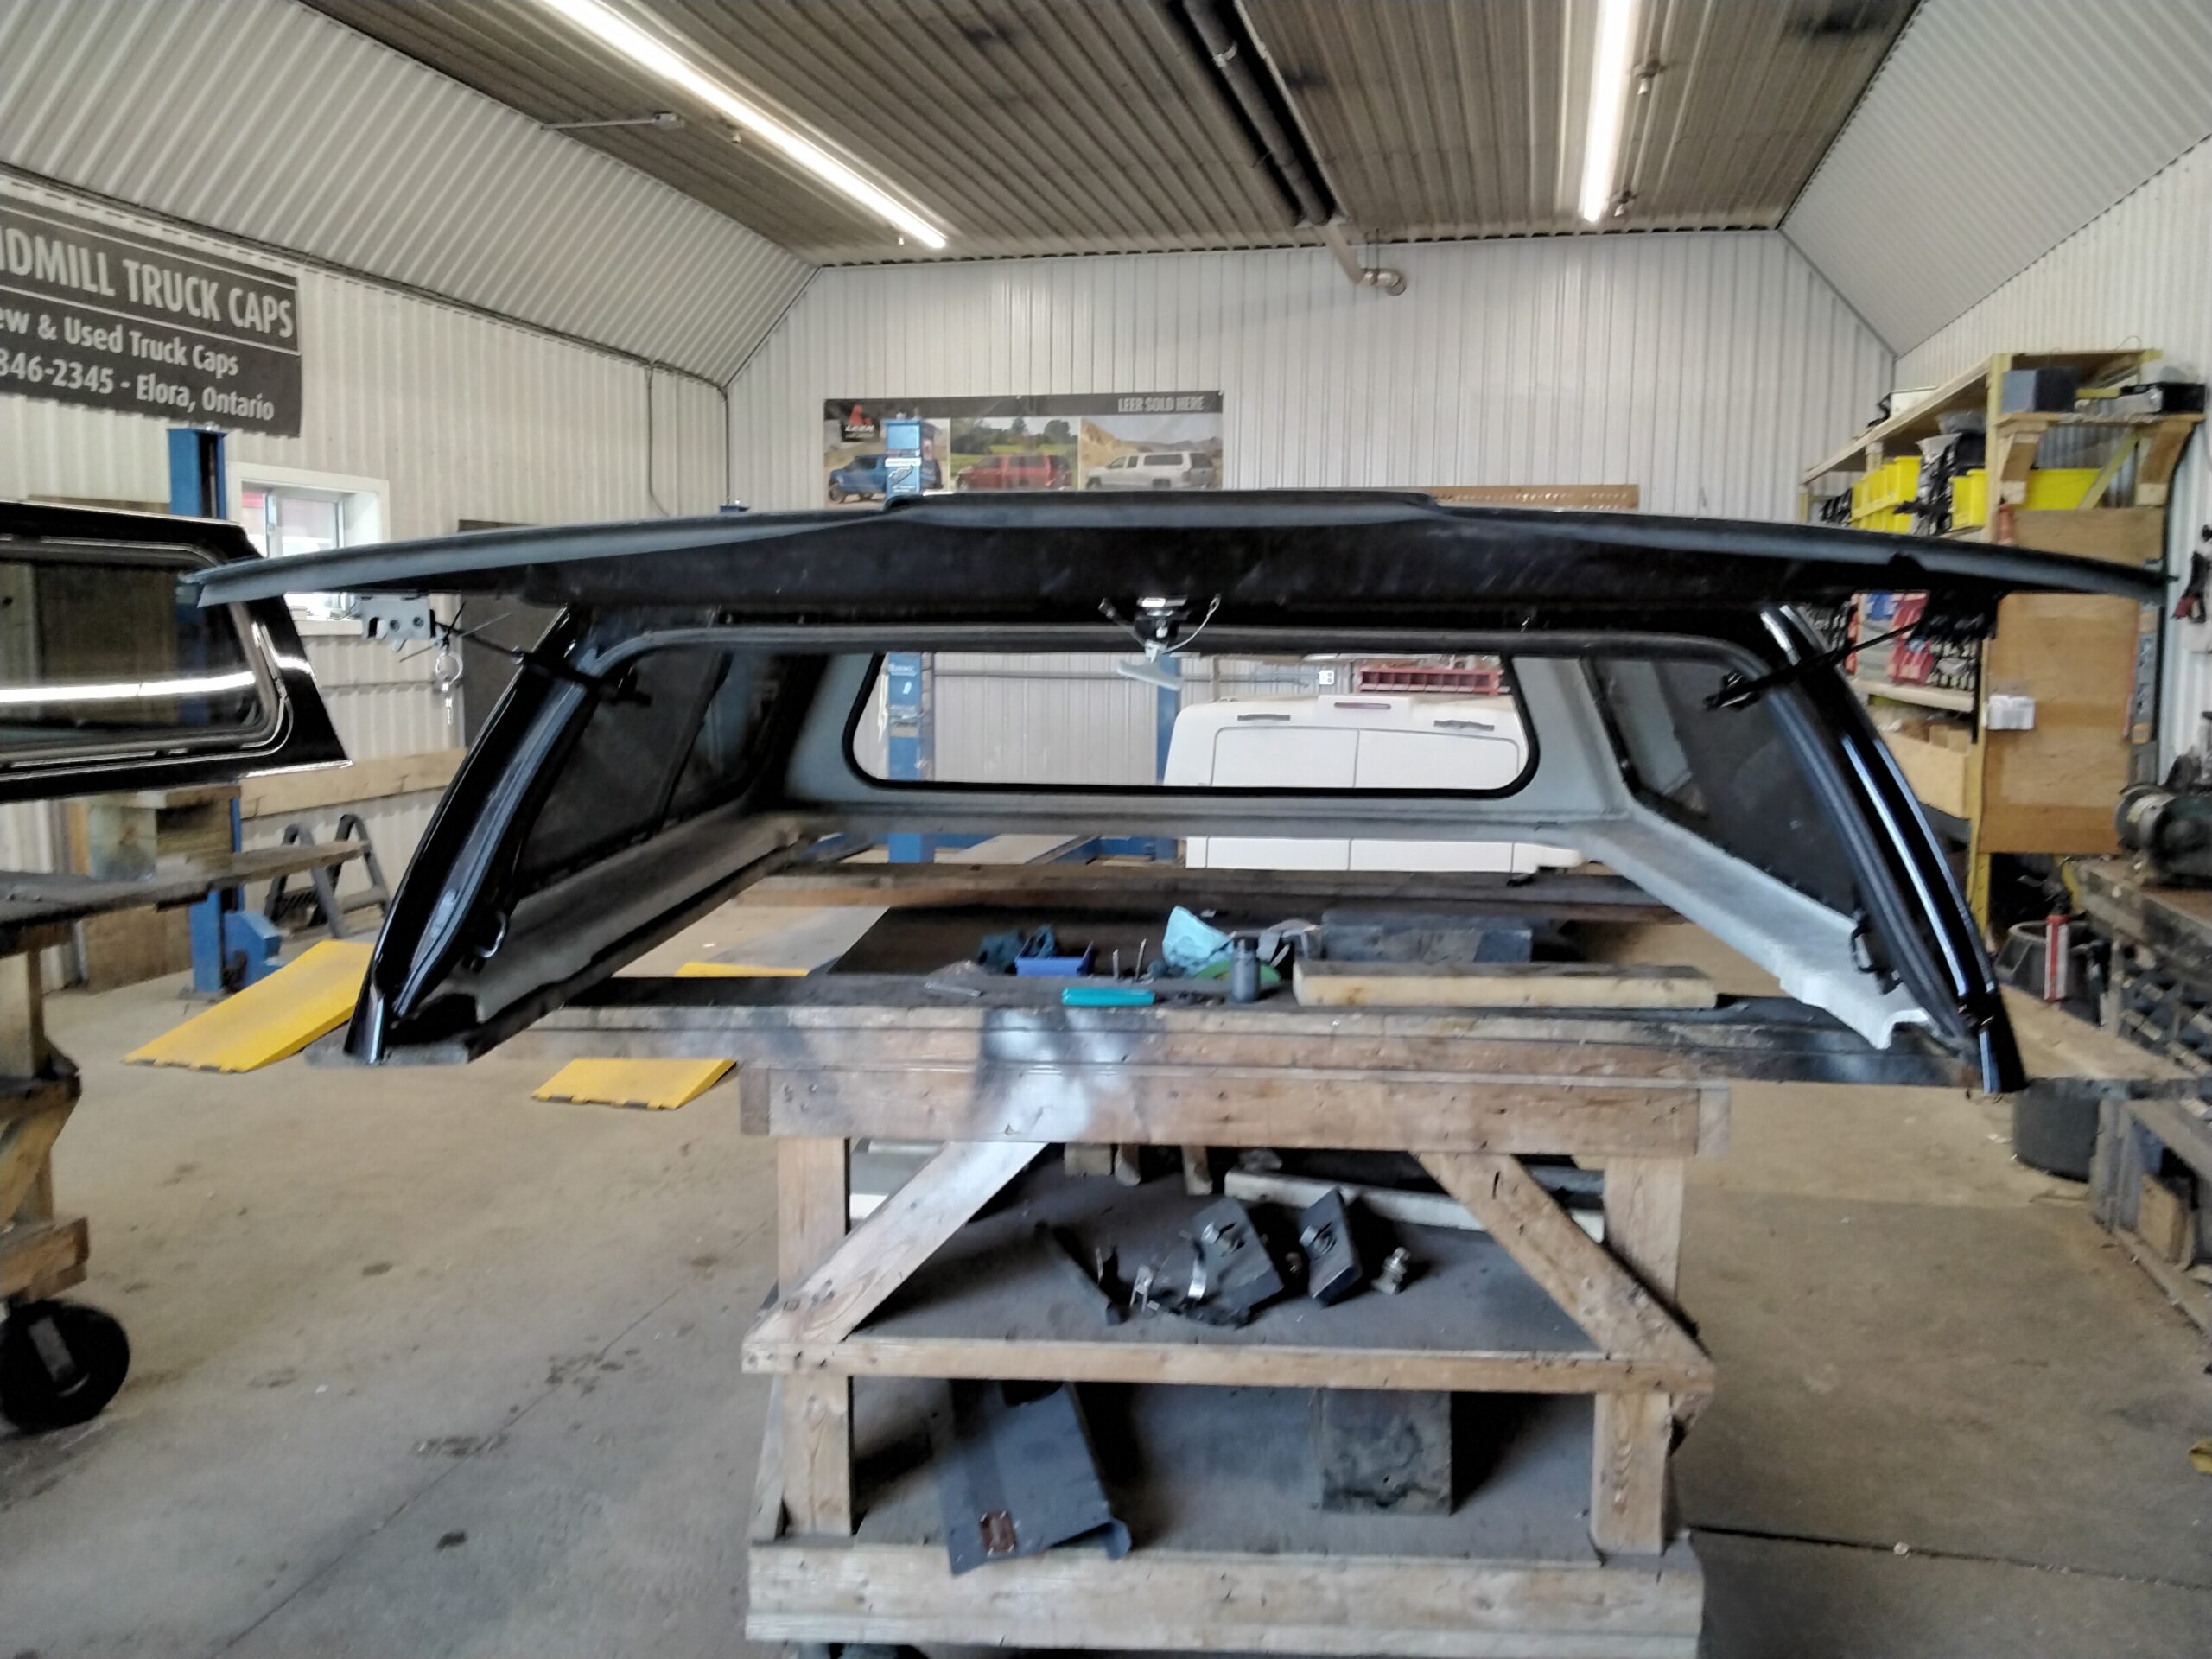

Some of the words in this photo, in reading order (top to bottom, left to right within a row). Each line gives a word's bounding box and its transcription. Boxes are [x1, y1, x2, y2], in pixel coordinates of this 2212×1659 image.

[0, 227, 116, 297] DMILL
[123, 259, 220, 322] TRUCK
[228, 287, 293, 338] CAPS
[37, 314, 57, 340] &
[64, 316, 124, 353] Used
[129, 330, 188, 365] Truck
[192, 345, 239, 379] Caps
[136, 373, 196, 413] Elora,
[201, 386, 275, 421] Ontario
[1118, 397, 1142, 412] LEER
[1145, 397, 1173, 411] SOLD
